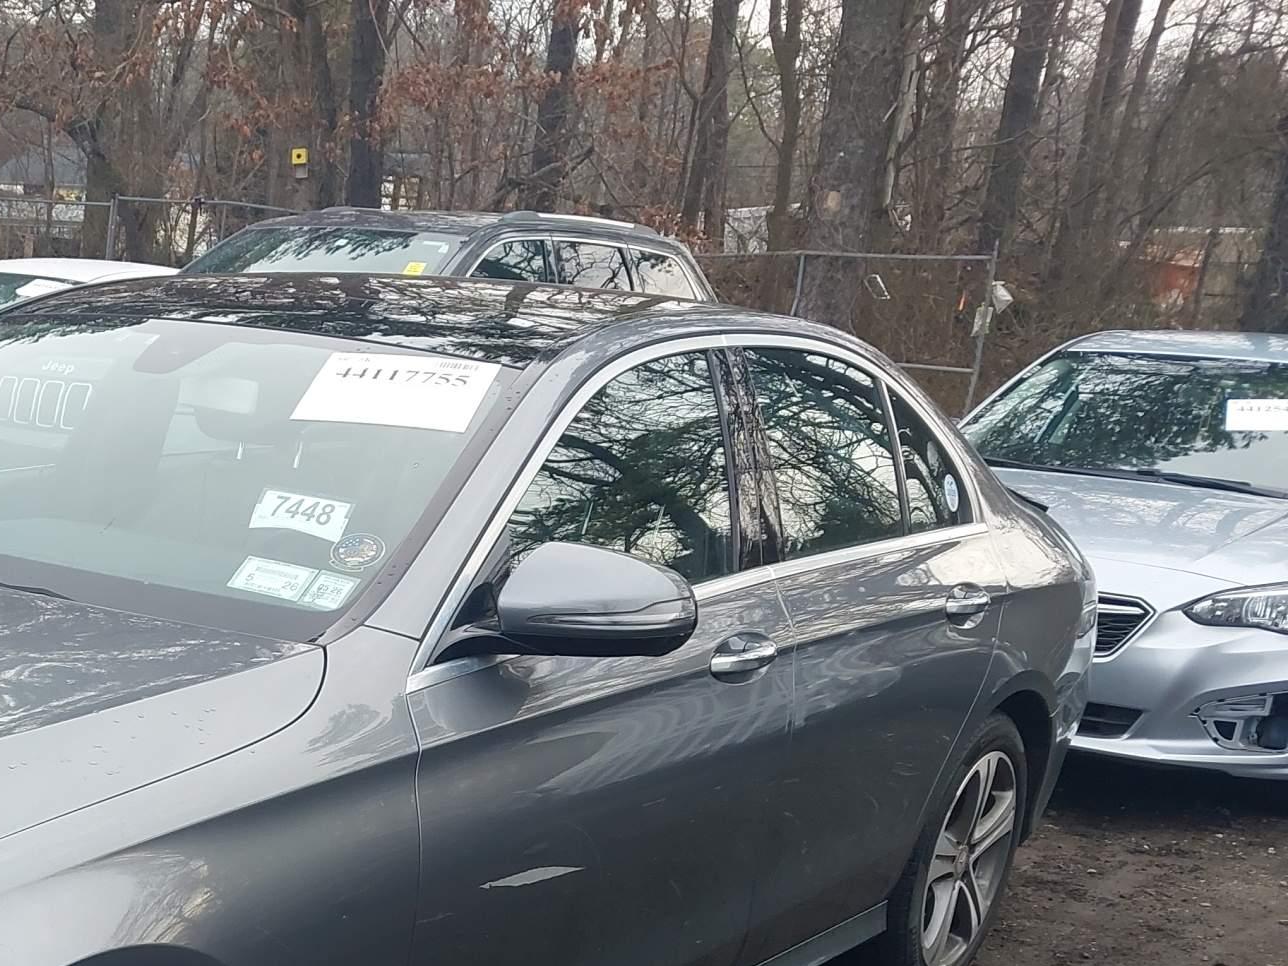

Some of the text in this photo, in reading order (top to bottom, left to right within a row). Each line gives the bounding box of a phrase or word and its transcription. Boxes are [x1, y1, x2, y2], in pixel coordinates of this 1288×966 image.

[42, 360, 75, 375] Jeep
[336, 367, 470, 388] 44117755
[270, 494, 336, 526] 7448
[280, 580, 298, 592] 26
